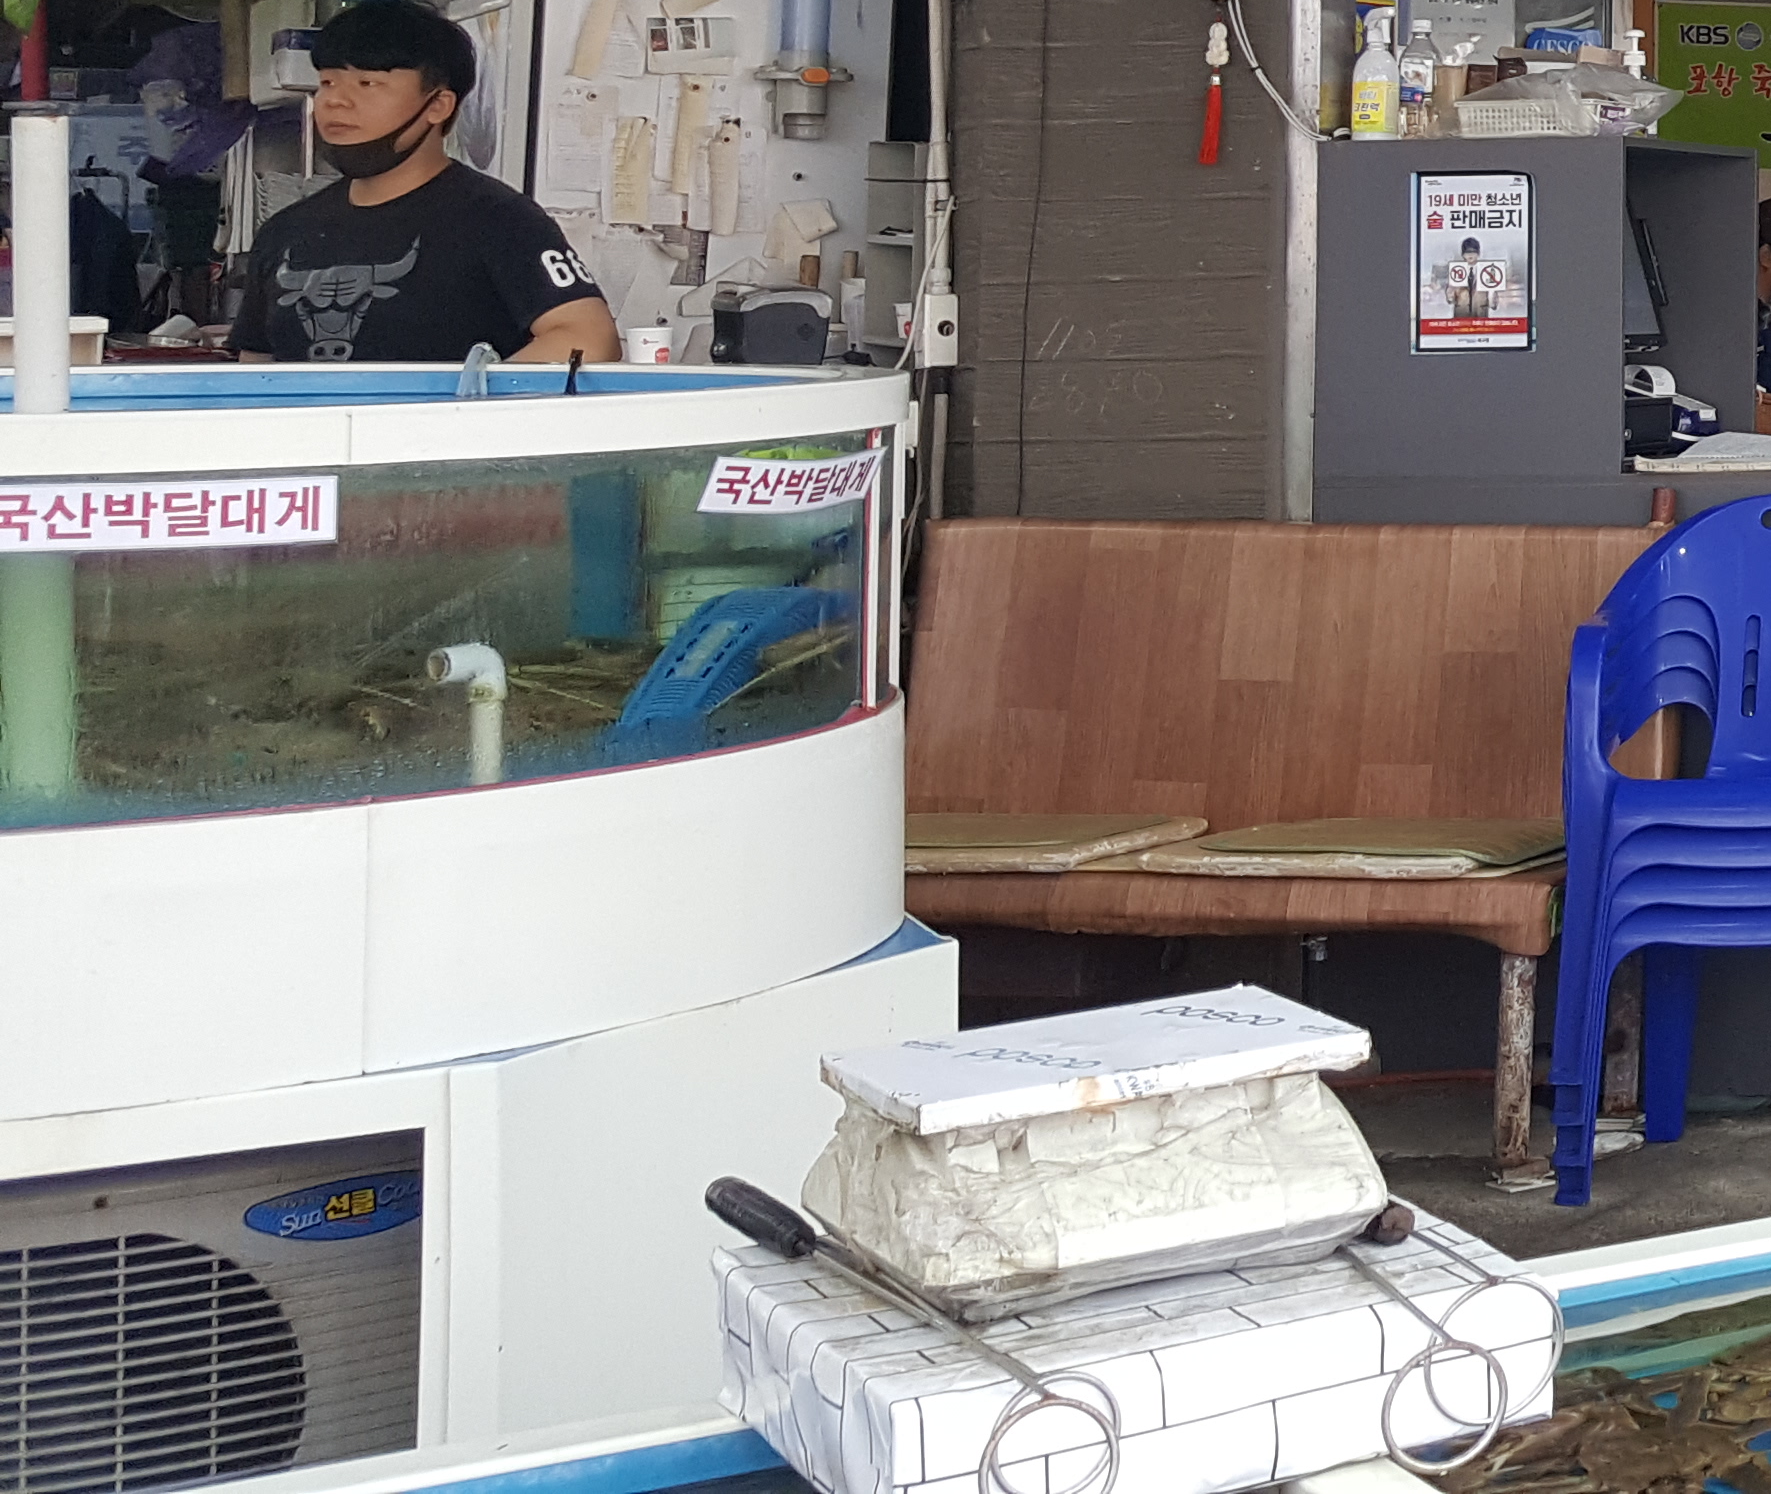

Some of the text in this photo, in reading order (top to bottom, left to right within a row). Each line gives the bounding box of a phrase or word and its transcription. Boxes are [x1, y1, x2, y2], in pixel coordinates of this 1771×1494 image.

[1680, 25, 1730, 46] KBS
[1686, 63, 1741, 98] 포항
[1428, 193, 1522, 207] 19세 미만 청소년
[1427, 210, 1522, 229] 술 판매금지
[714, 453, 876, 507] 국산박달대게
[1141, 1004, 1285, 1028] posco
[954, 1046, 1102, 1071] posco
[280, 1209, 322, 1237] Sun
